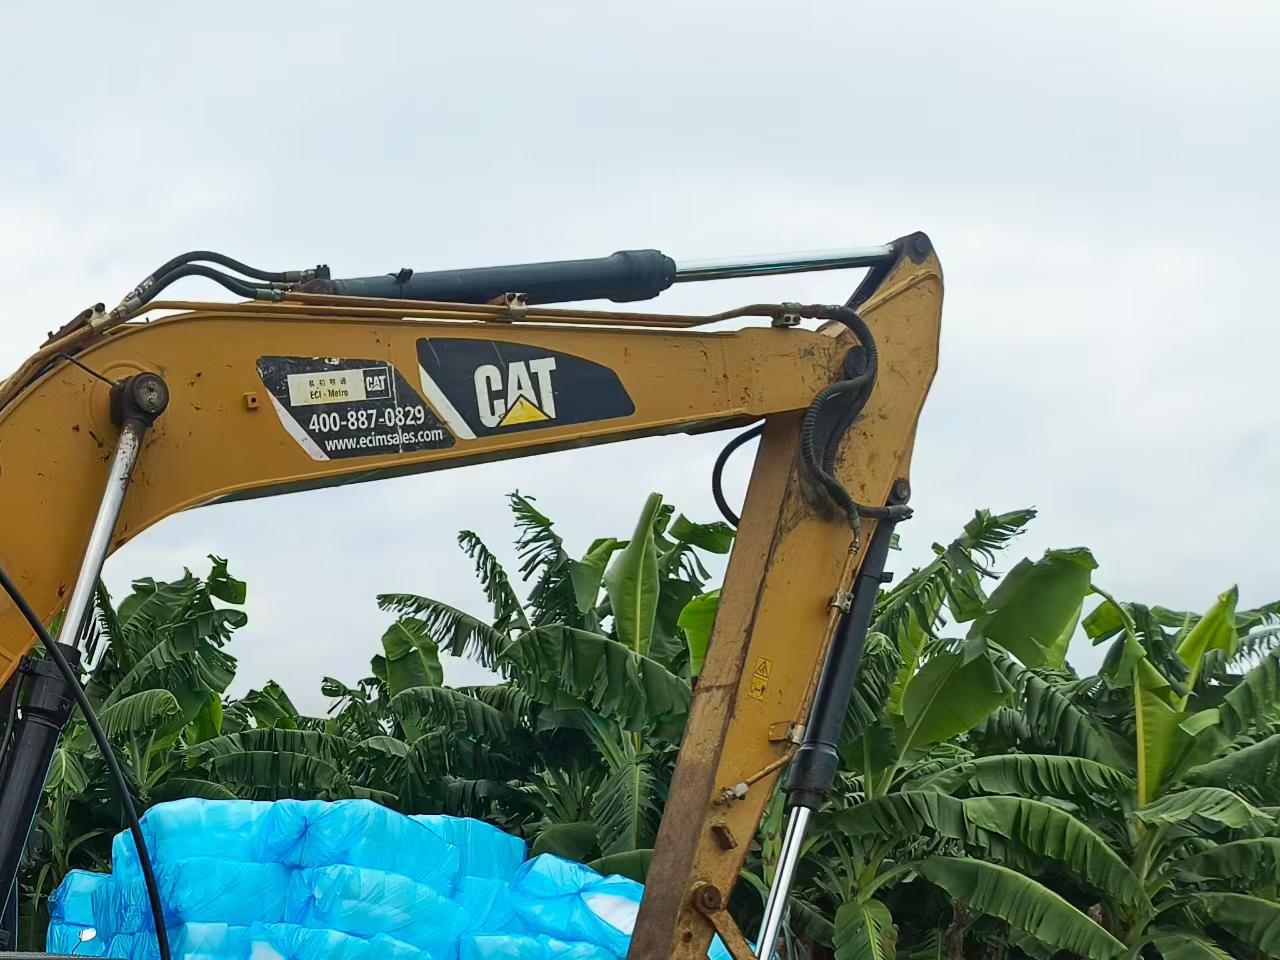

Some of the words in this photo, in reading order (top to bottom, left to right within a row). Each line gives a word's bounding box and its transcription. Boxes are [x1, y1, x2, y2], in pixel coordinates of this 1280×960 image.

[309, 390, 322, 400] ECI
[328, 389, 349, 399] Metro
[365, 376, 386, 392] CAT
[473, 357, 557, 428] CAT
[308, 405, 425, 433] 400-887-0829
[325, 428, 443, 451] www.ecimsales.com
